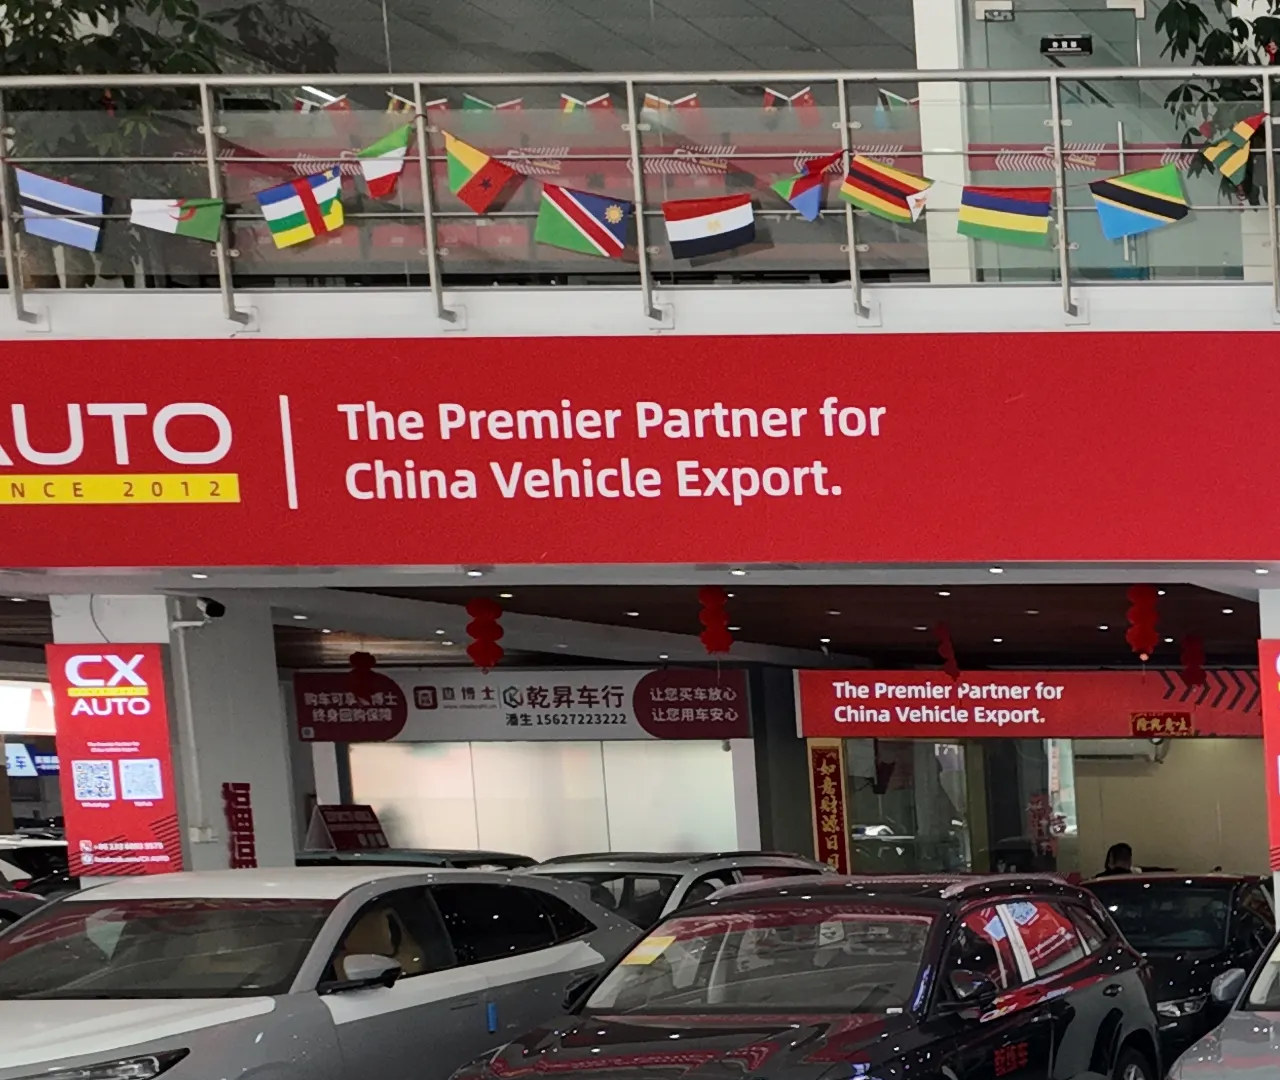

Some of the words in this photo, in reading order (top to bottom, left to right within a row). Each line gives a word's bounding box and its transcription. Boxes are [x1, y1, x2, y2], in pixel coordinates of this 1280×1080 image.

[338, 401, 423, 440] The
[439, 400, 621, 439] Premier
[636, 402, 807, 438] Partner
[820, 397, 886, 436] for
[0, 402, 232, 466] UTO
[122, 480, 222, 498] 2012
[346, 460, 476, 499] China
[490, 458, 661, 498] Vehicle
[677, 461, 841, 505] Export.
[65, 654, 148, 687] CX
[833, 681, 869, 698] The
[875, 682, 951, 698] Premier
[958, 683, 1030, 699] Partner
[1035, 682, 1064, 699] for
[71, 698, 151, 716] AUTO
[835, 706, 890, 722] China
[896, 706, 968, 722] Vehicle
[975, 707, 1045, 726] Export.
[536, 713, 627, 725] 15627223222
